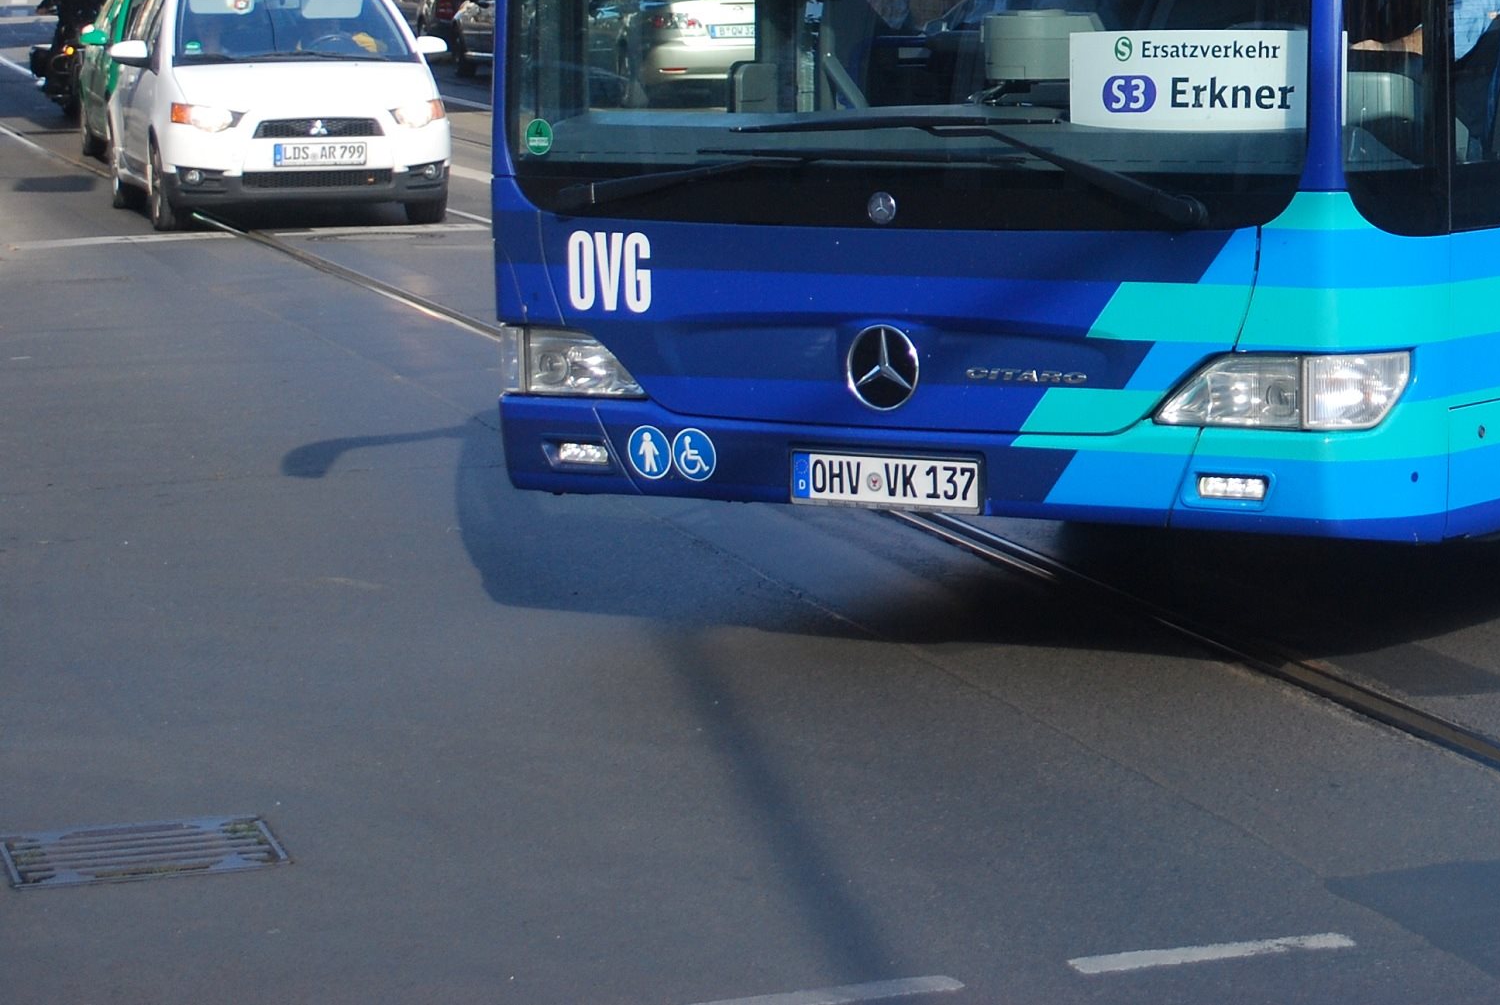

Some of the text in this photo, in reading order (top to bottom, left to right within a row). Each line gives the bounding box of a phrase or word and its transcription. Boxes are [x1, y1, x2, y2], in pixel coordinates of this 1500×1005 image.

[1141, 40, 1281, 59] Ersatzverkehr
[1110, 76, 1295, 110] S3 Erkner
[535, 121, 543, 137] 4
[283, 145, 365, 160] LDS AR 799
[568, 230, 652, 314] OVG
[966, 366, 1088, 384] CITARO
[811, 459, 861, 494] OHV
[884, 462, 918, 498] VK
[925, 465, 976, 501] 137
